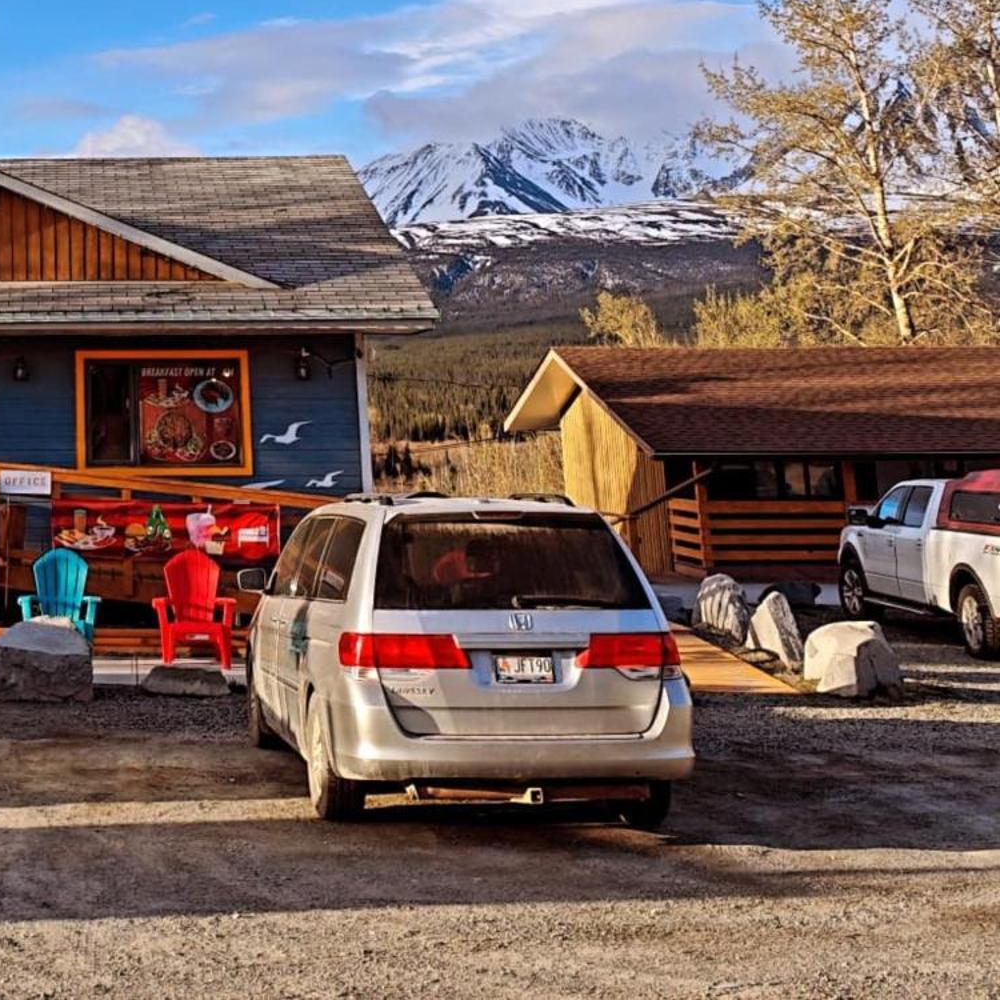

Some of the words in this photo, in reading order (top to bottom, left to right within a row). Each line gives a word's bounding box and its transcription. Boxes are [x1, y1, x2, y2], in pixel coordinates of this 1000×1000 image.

[141, 367, 182, 377] BREAKFAST
[184, 367, 204, 377] OPEN
[4, 476, 47, 487] OFFICE
[514, 657, 552, 673] JFT90
